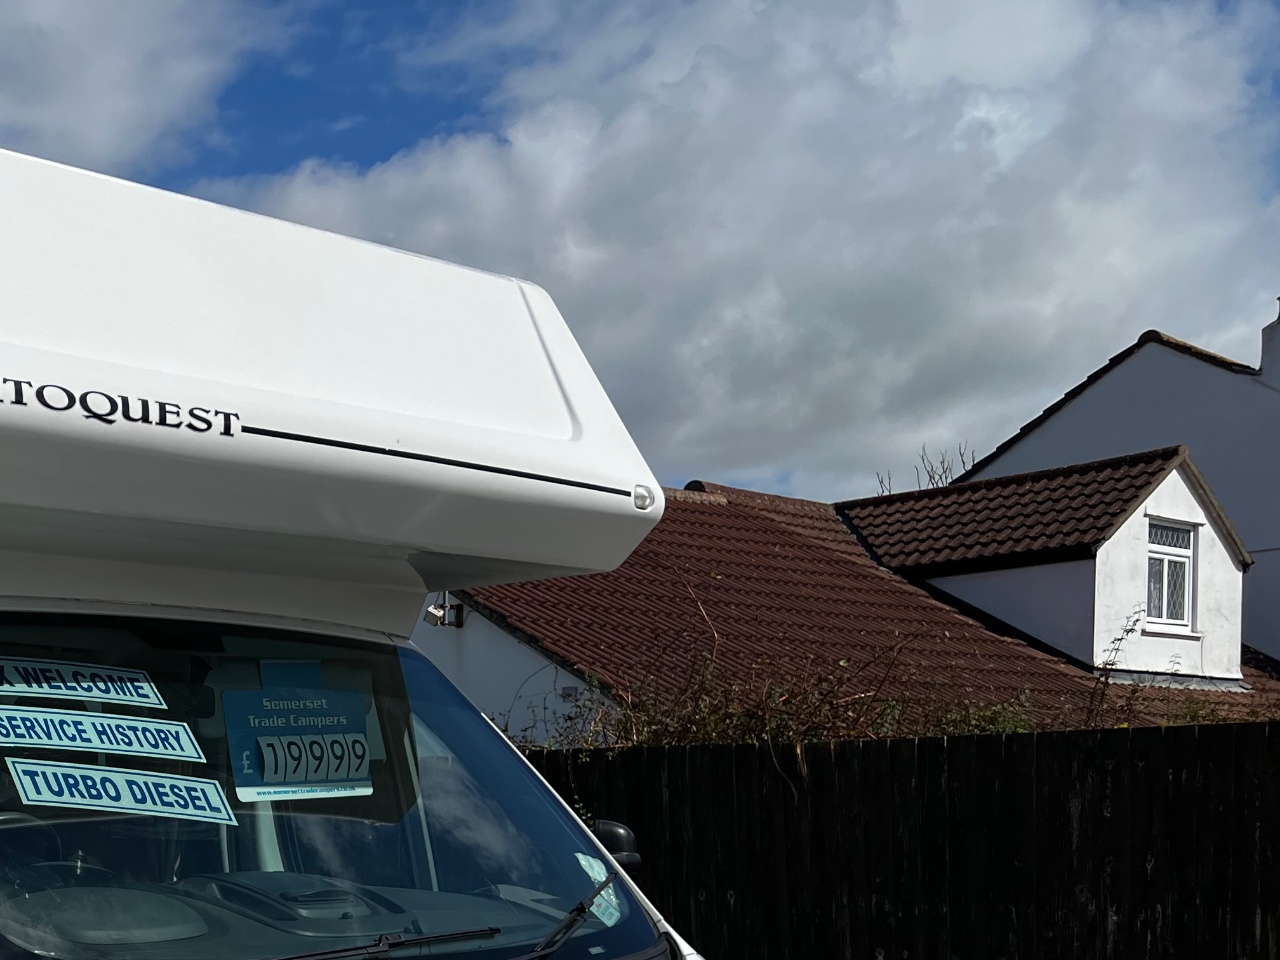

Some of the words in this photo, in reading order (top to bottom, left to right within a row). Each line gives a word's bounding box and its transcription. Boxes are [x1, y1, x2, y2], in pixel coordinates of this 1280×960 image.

[13, 665, 151, 699] WELCOME
[262, 698, 329, 711] Somerset
[91, 721, 186, 752] HISTORY
[247, 715, 286, 728] Trade
[290, 714, 348, 729] Campers
[21, 769, 122, 802] TURBO
[125, 779, 223, 814] DIESEL
